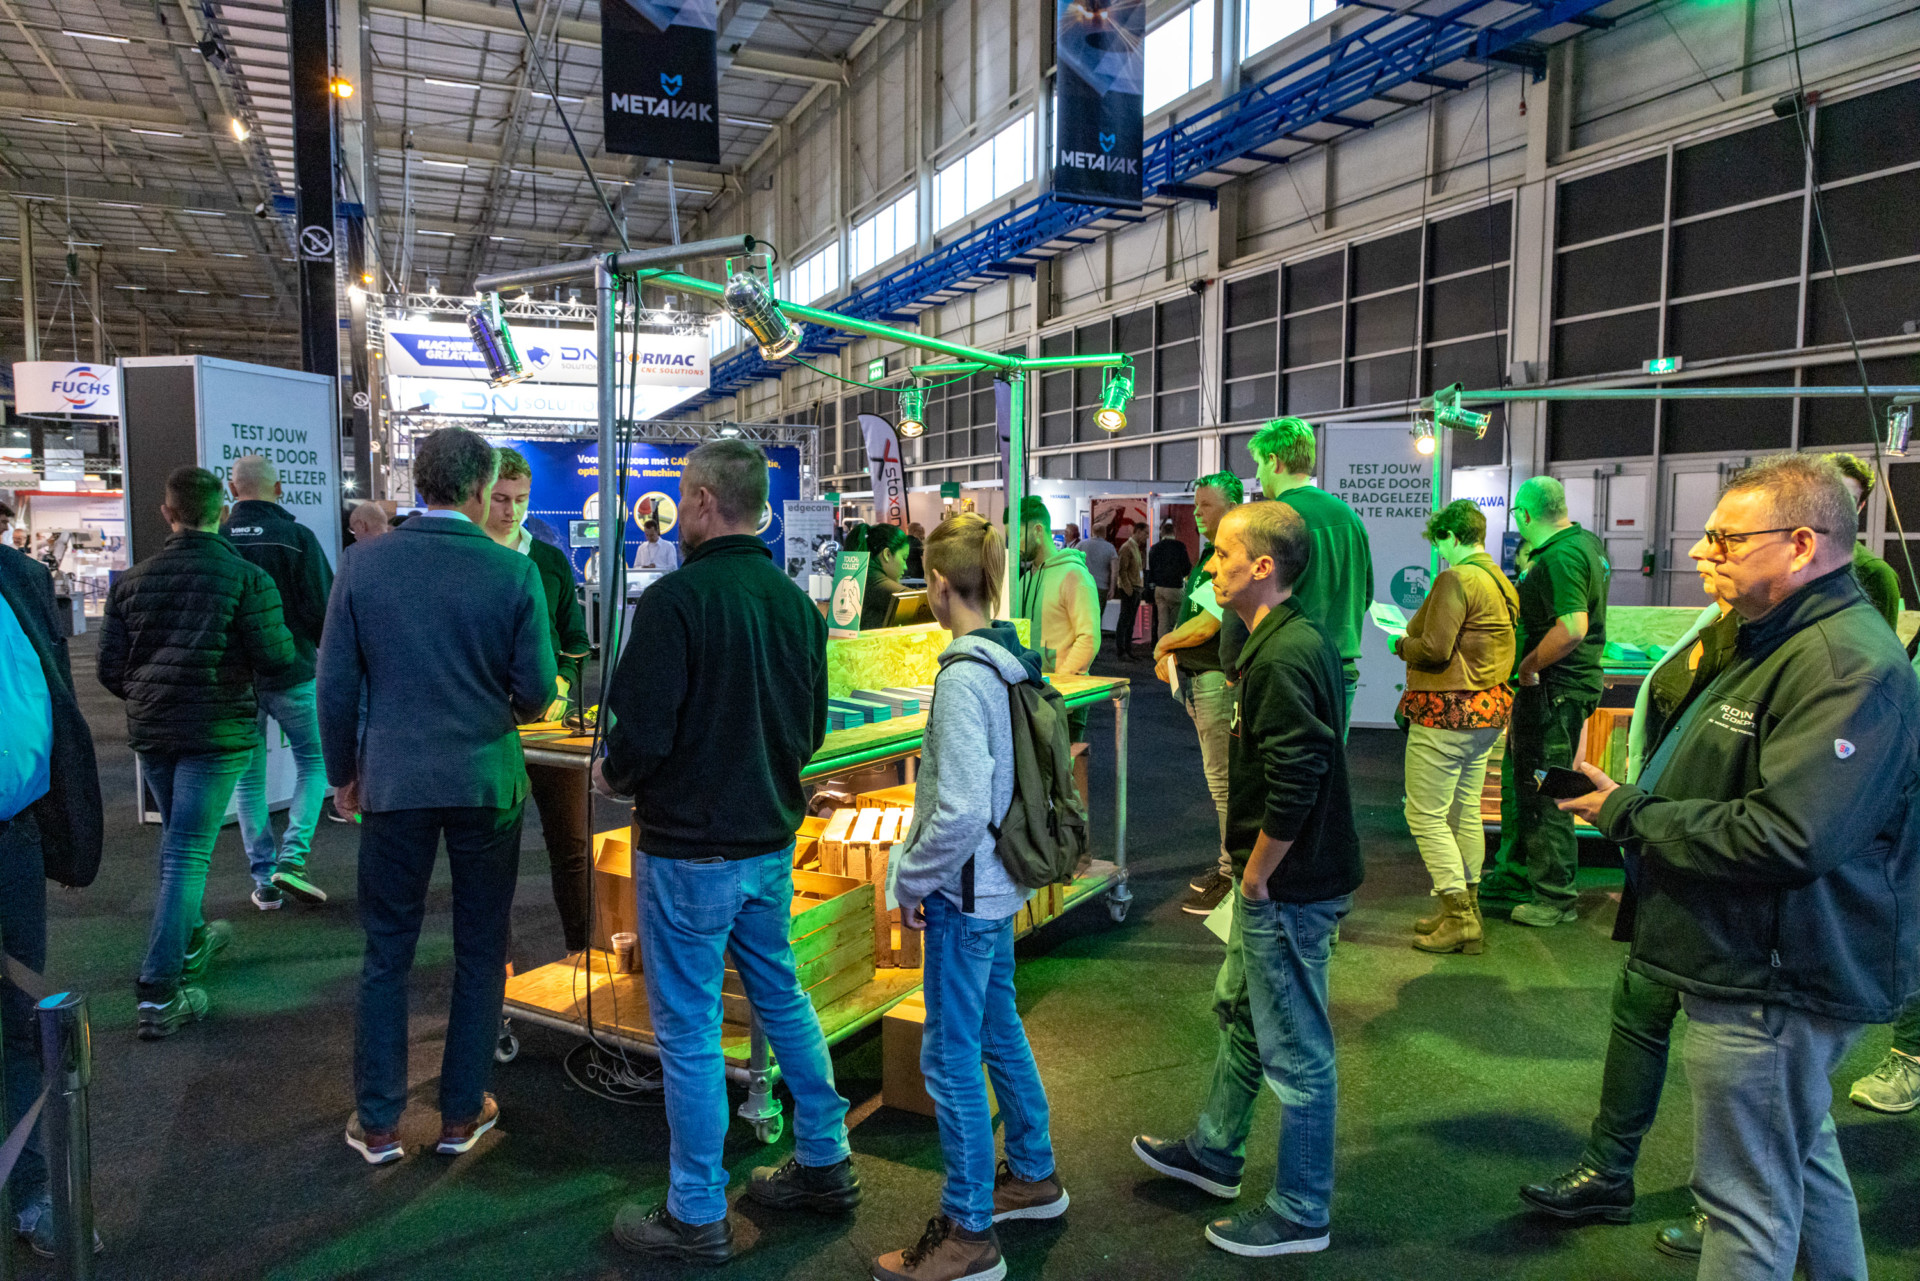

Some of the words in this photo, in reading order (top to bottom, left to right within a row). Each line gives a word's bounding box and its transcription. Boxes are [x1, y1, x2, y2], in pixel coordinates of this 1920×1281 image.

[611, 92, 713, 122] METAVAK
[1061, 150, 1138, 175] METAVAK
[425, 349, 486, 362] GREATNES
[660, 367, 705, 376] SOLUTIONS
[51, 380, 110, 396] FUCHS
[462, 393, 518, 412] DN
[524, 399, 595, 412] SOLUTIO
[231, 424, 264, 440] TEST
[267, 427, 307, 444] JOUW
[277, 449, 318, 465] DOOR
[651, 457, 669, 465] met
[643, 468, 681, 477] machine
[1349, 464, 1379, 474] TEST
[1381, 464, 1422, 474] JOUW
[1339, 478, 1385, 488] BADGE
[1389, 478, 1430, 488] DOOR
[1352, 493, 1432, 503] BADGELEZE
[788, 504, 831, 513] edgecam
[1369, 507, 1382, 517] TE
[1386, 507, 1432, 517] RAKEN
